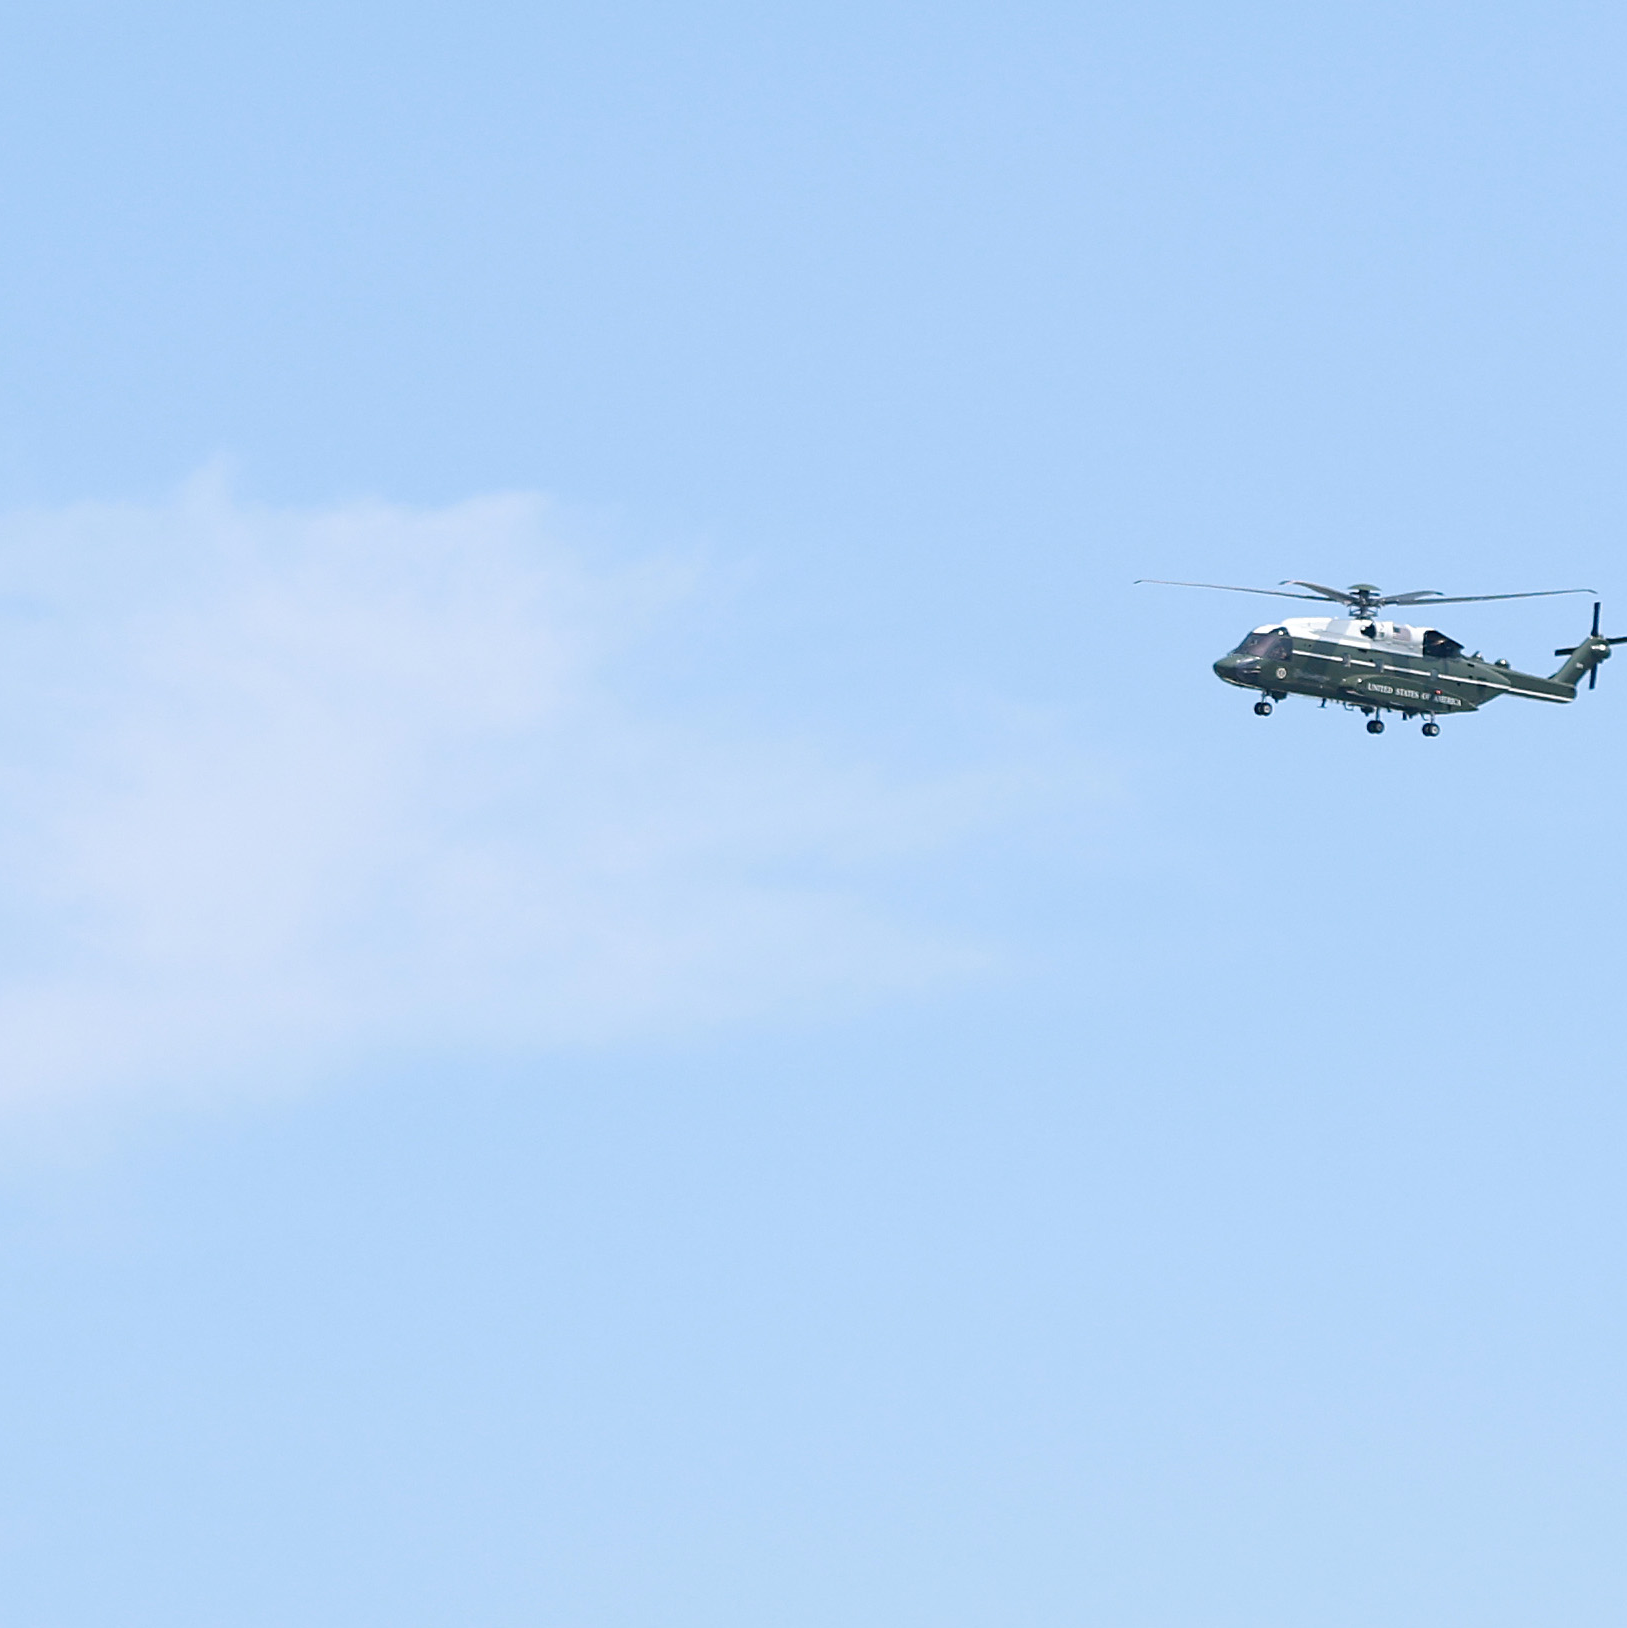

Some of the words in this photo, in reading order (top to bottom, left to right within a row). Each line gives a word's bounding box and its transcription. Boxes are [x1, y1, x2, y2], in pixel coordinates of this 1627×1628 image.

[1367, 683, 1394, 694] UNITED
[1395, 688, 1420, 699] STATES
[1434, 695, 1462, 707] AMERICA
